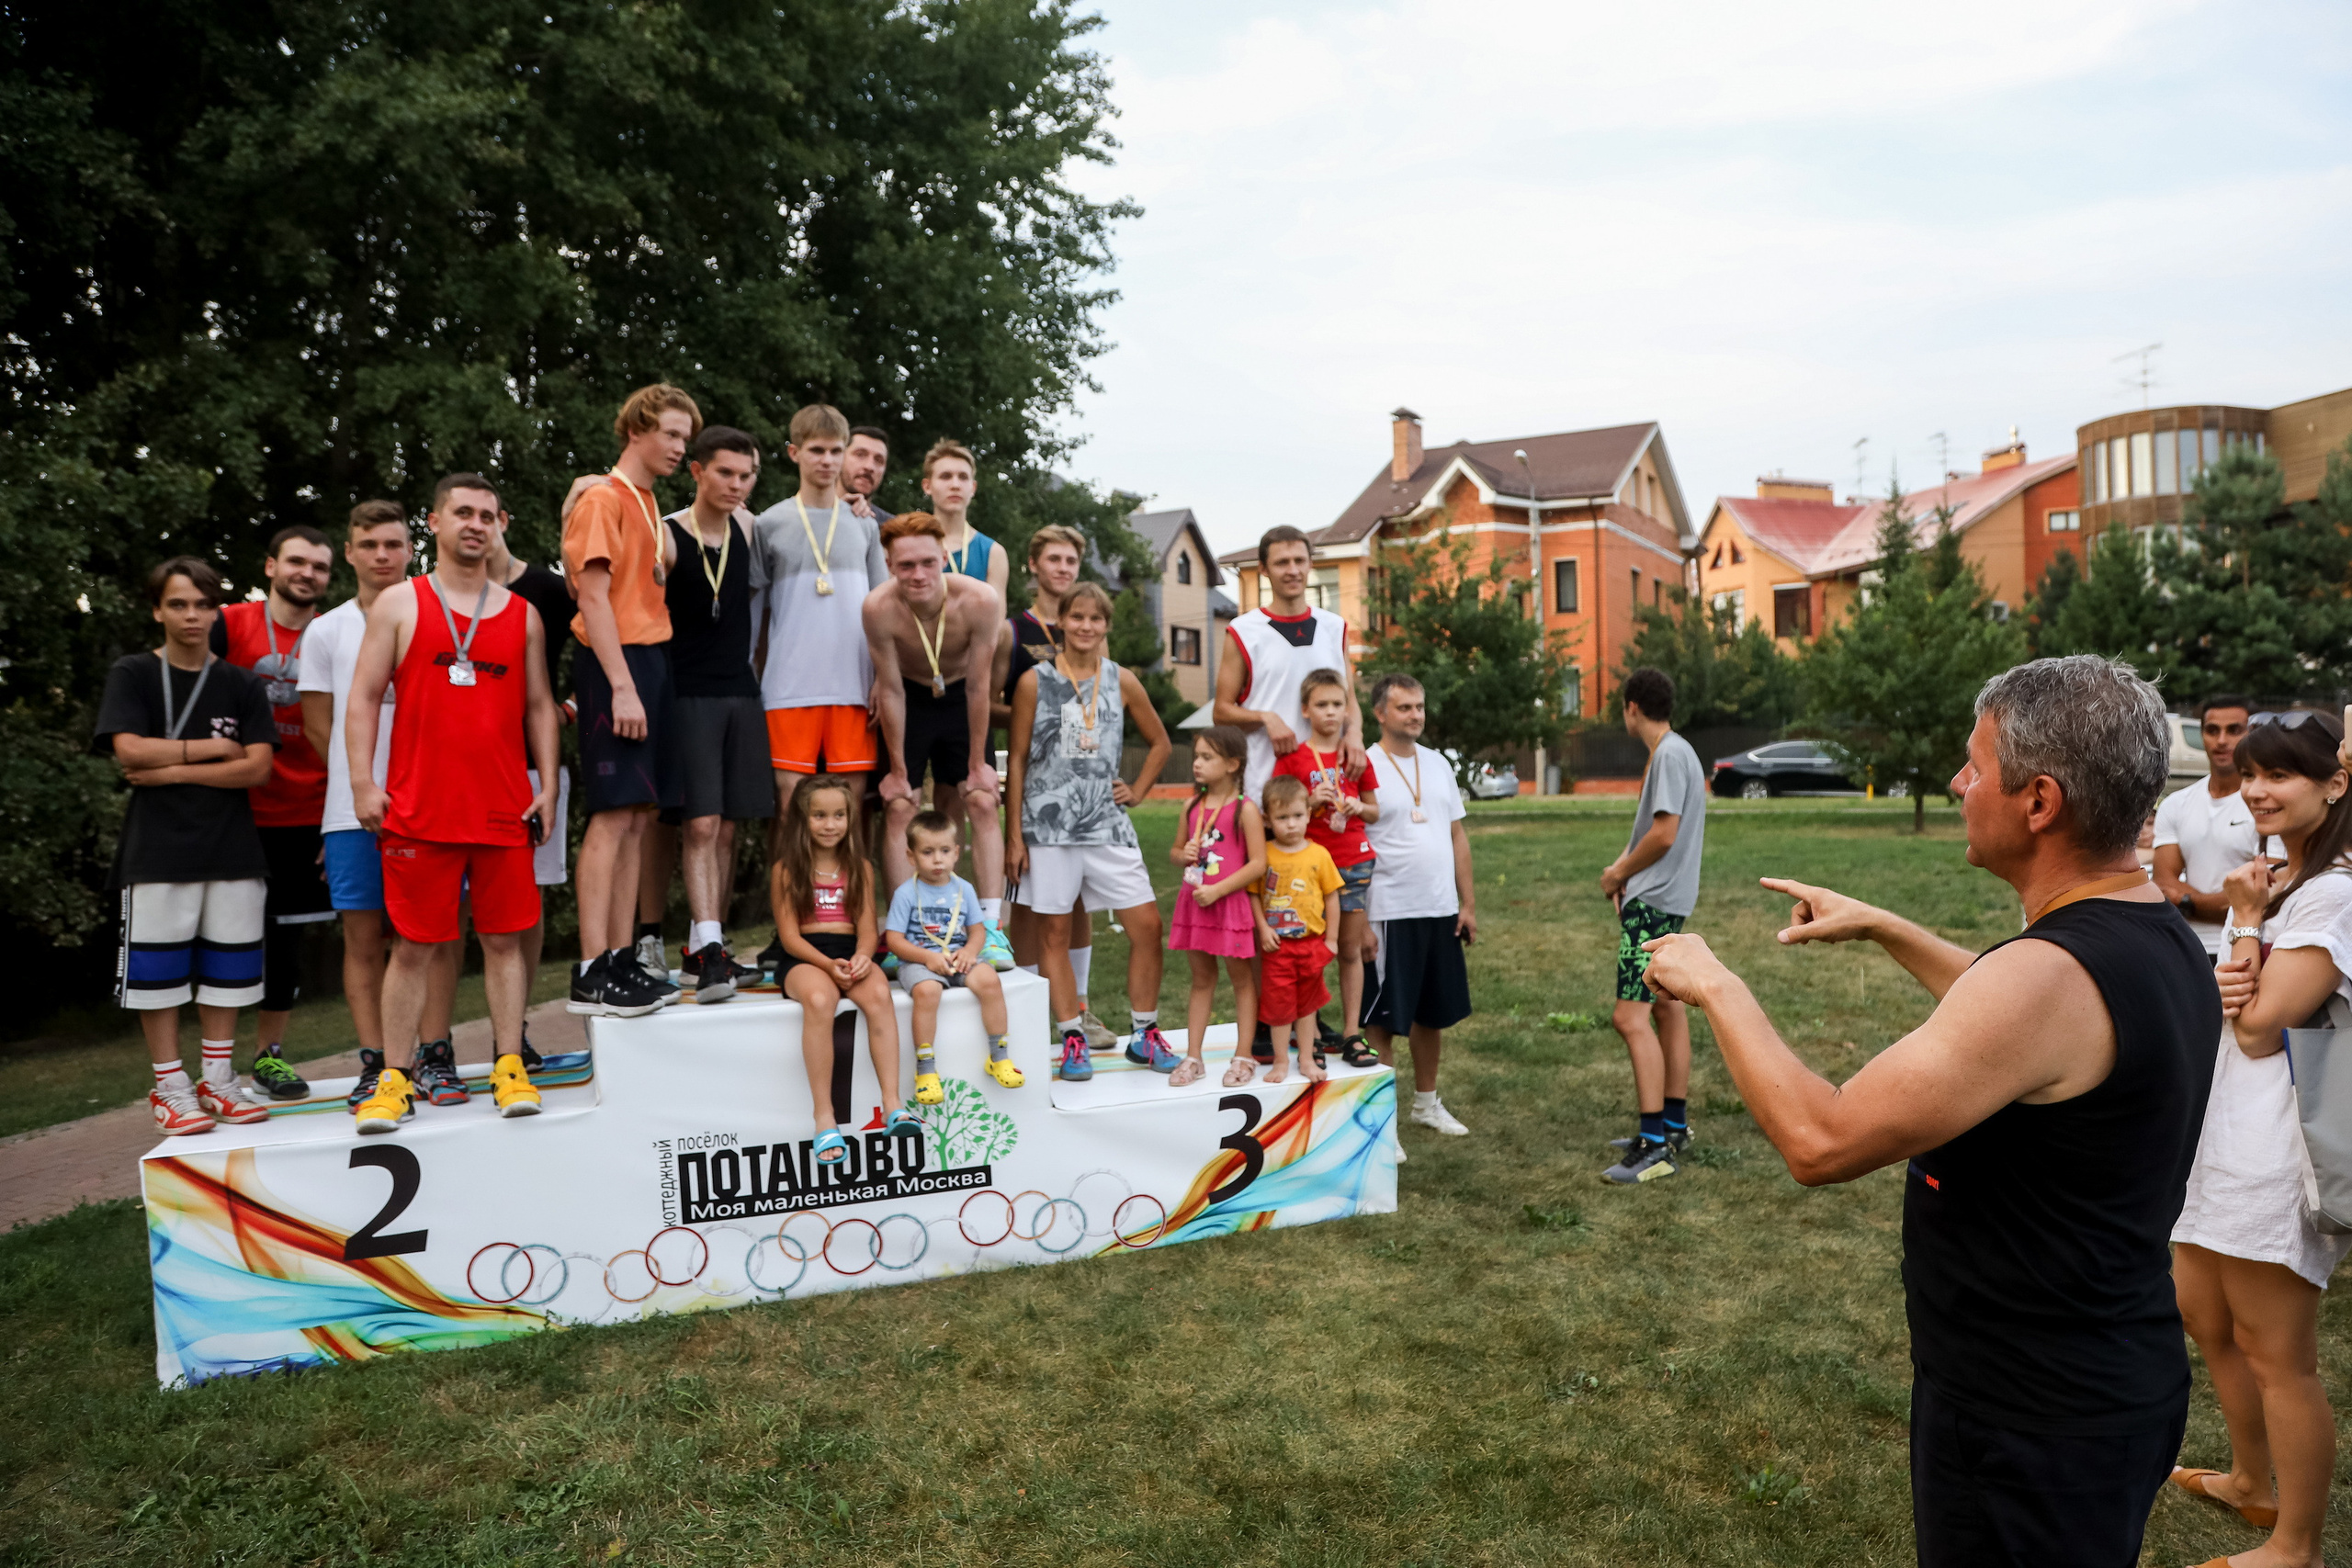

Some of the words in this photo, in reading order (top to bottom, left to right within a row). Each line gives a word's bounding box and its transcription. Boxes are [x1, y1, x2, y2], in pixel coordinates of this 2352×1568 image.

[677, 1131, 739, 1151] посёлок
[677, 1131, 926, 1202] ПОТАПОВО
[1207, 1093, 1264, 1205] 3
[344, 1144, 429, 1261] 2
[652, 1138, 678, 1228] коттеджный
[690, 1201, 747, 1220] Моя
[753, 1182, 889, 1213] маленькая
[896, 1171, 988, 1195] Москва
